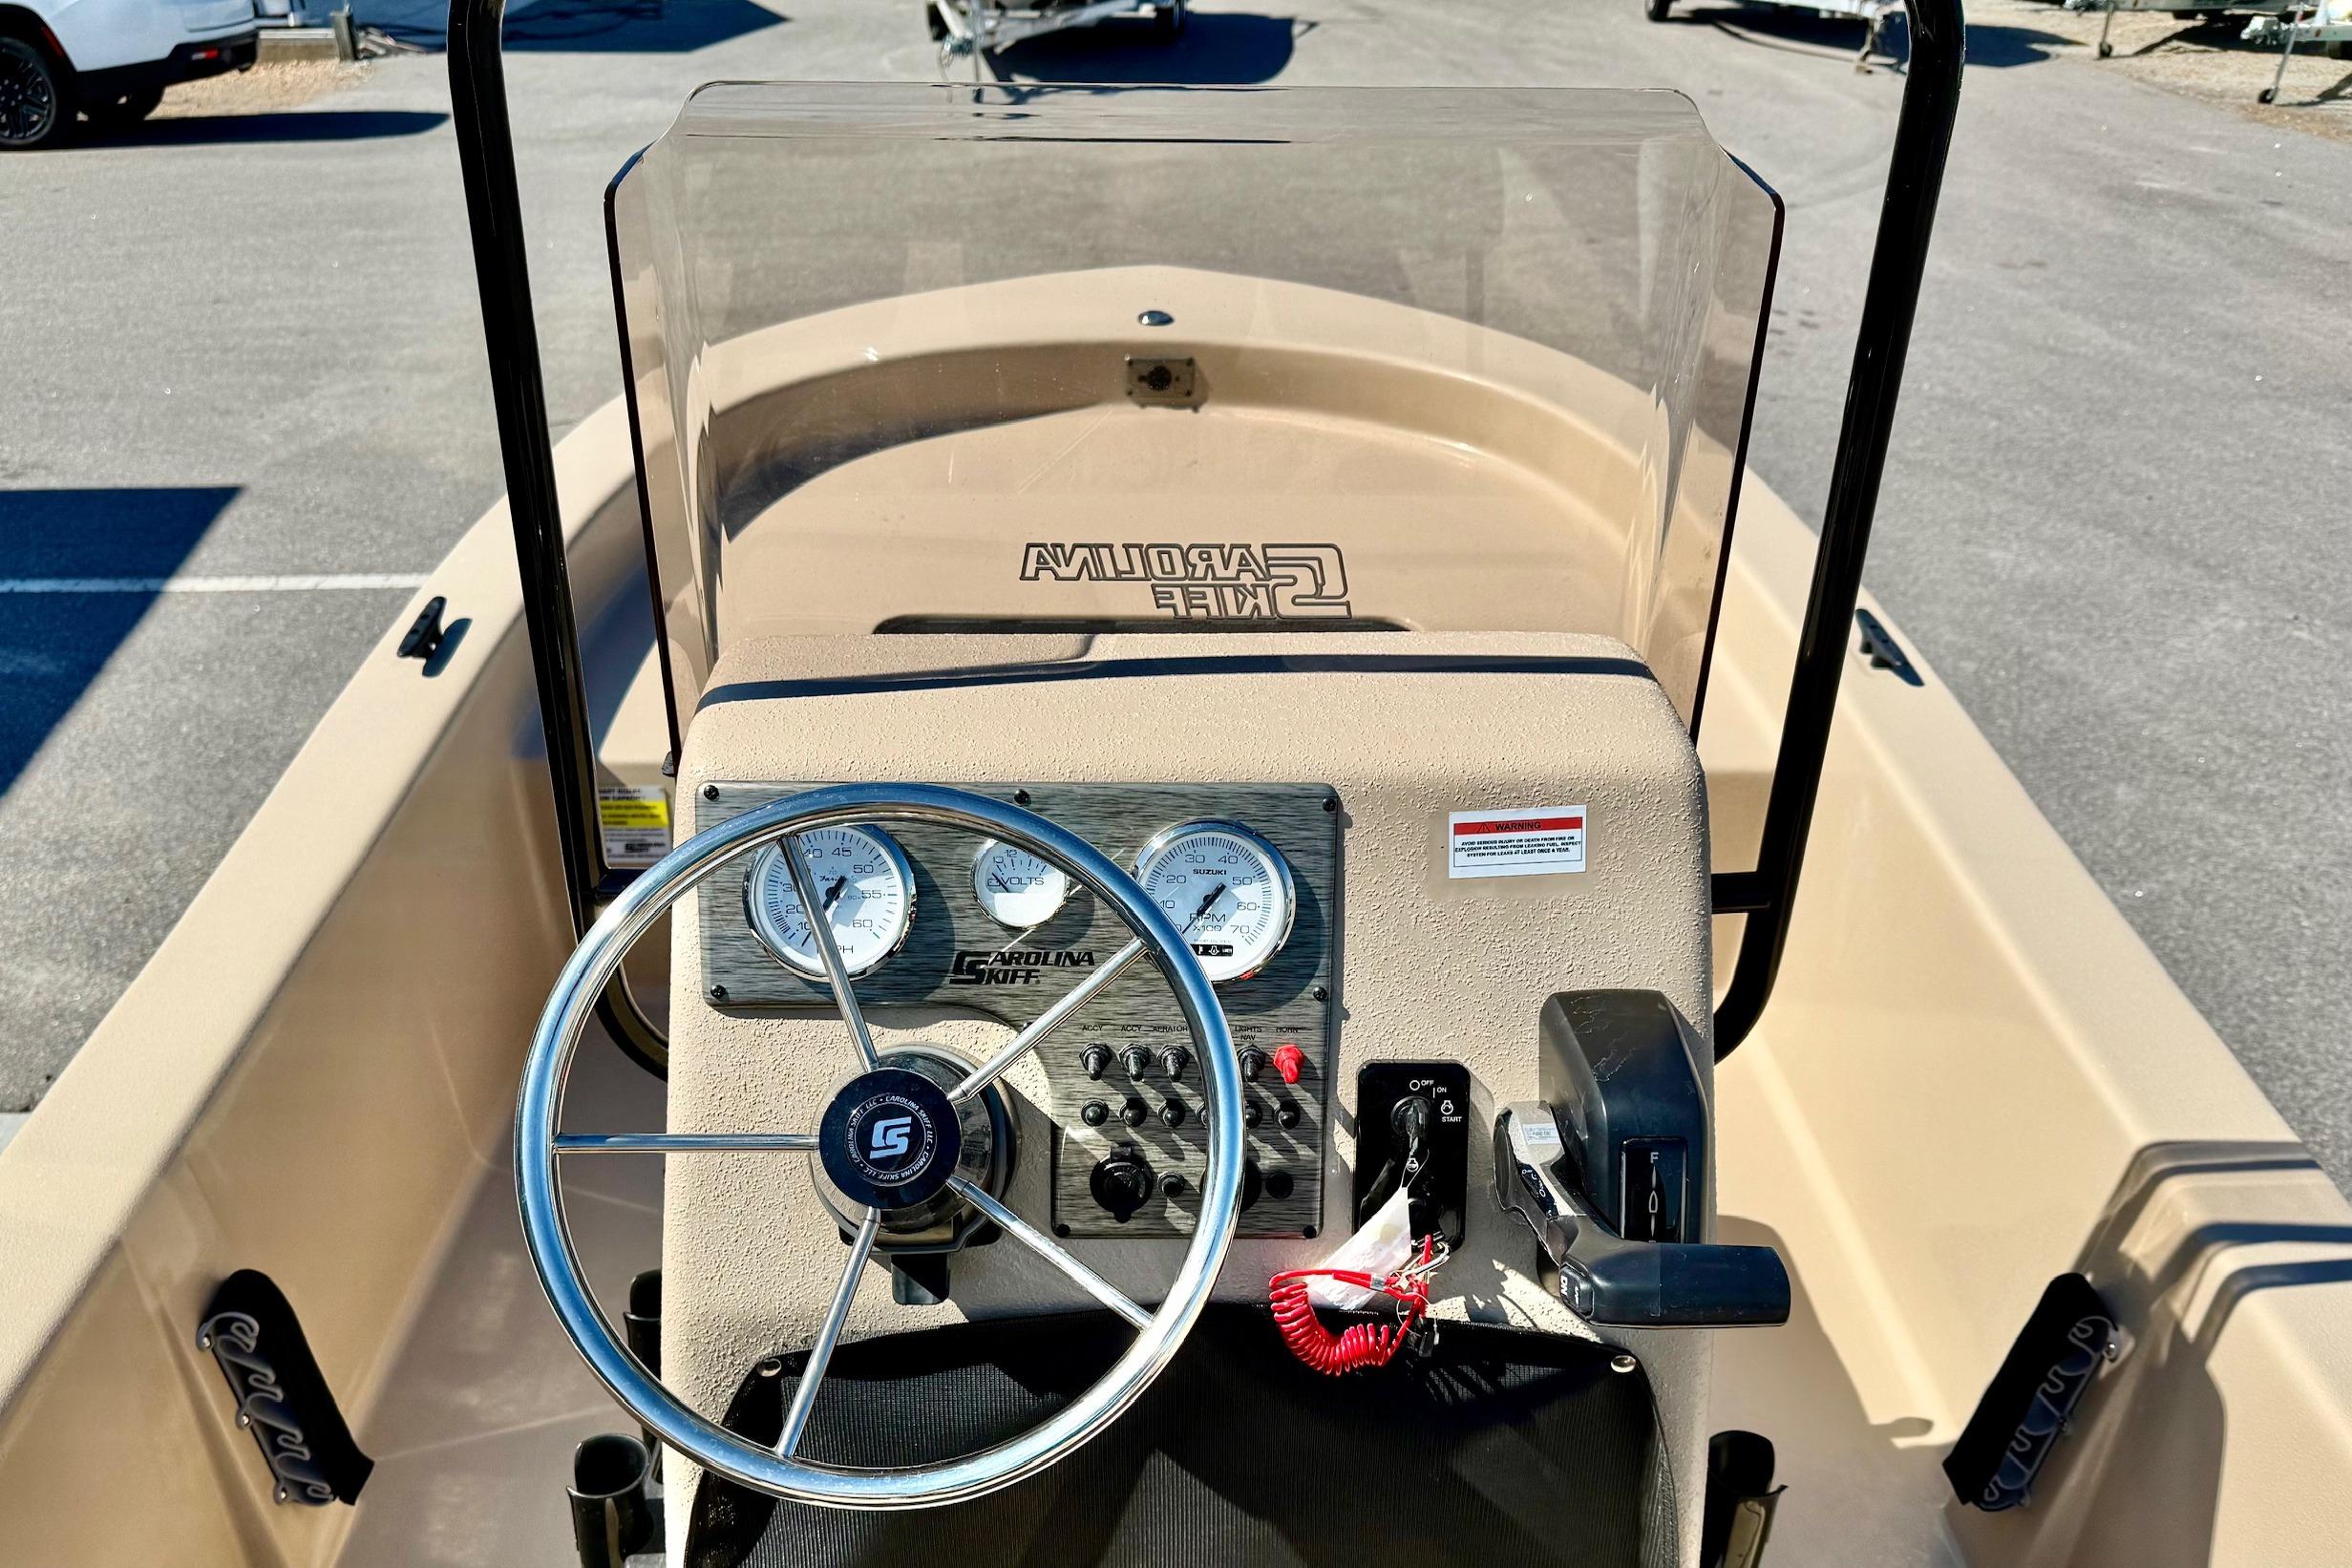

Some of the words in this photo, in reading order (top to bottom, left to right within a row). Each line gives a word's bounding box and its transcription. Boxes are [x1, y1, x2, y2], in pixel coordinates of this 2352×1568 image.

[1495, 822, 1541, 831] WARNING
[804, 848, 823, 858] 40
[831, 847, 852, 857] 45
[1005, 849, 1018, 858] 12
[1185, 854, 1205, 864] 30
[1218, 855, 1239, 864] 40
[853, 864, 874, 874] 50
[1001, 877, 1045, 885] VOLTS
[1166, 875, 1186, 884] 20
[1232, 877, 1253, 886] 50
[861, 889, 882, 900] 55
[1159, 900, 1176, 909] 10
[1237, 901, 1257, 911] 60
[1189, 913, 1226, 923] RPM
[852, 919, 873, 928] 60
[1230, 924, 1250, 935] 70
[952, 950, 1095, 975] CAROLINA
[949, 961, 1041, 985] SKIFF
[885, 1095, 920, 1111] CAROLINA
[918, 1110, 933, 1129] SKIFF
[1650, 1151, 1660, 1164] F
[901, 1150, 929, 1177] CAROLINA
